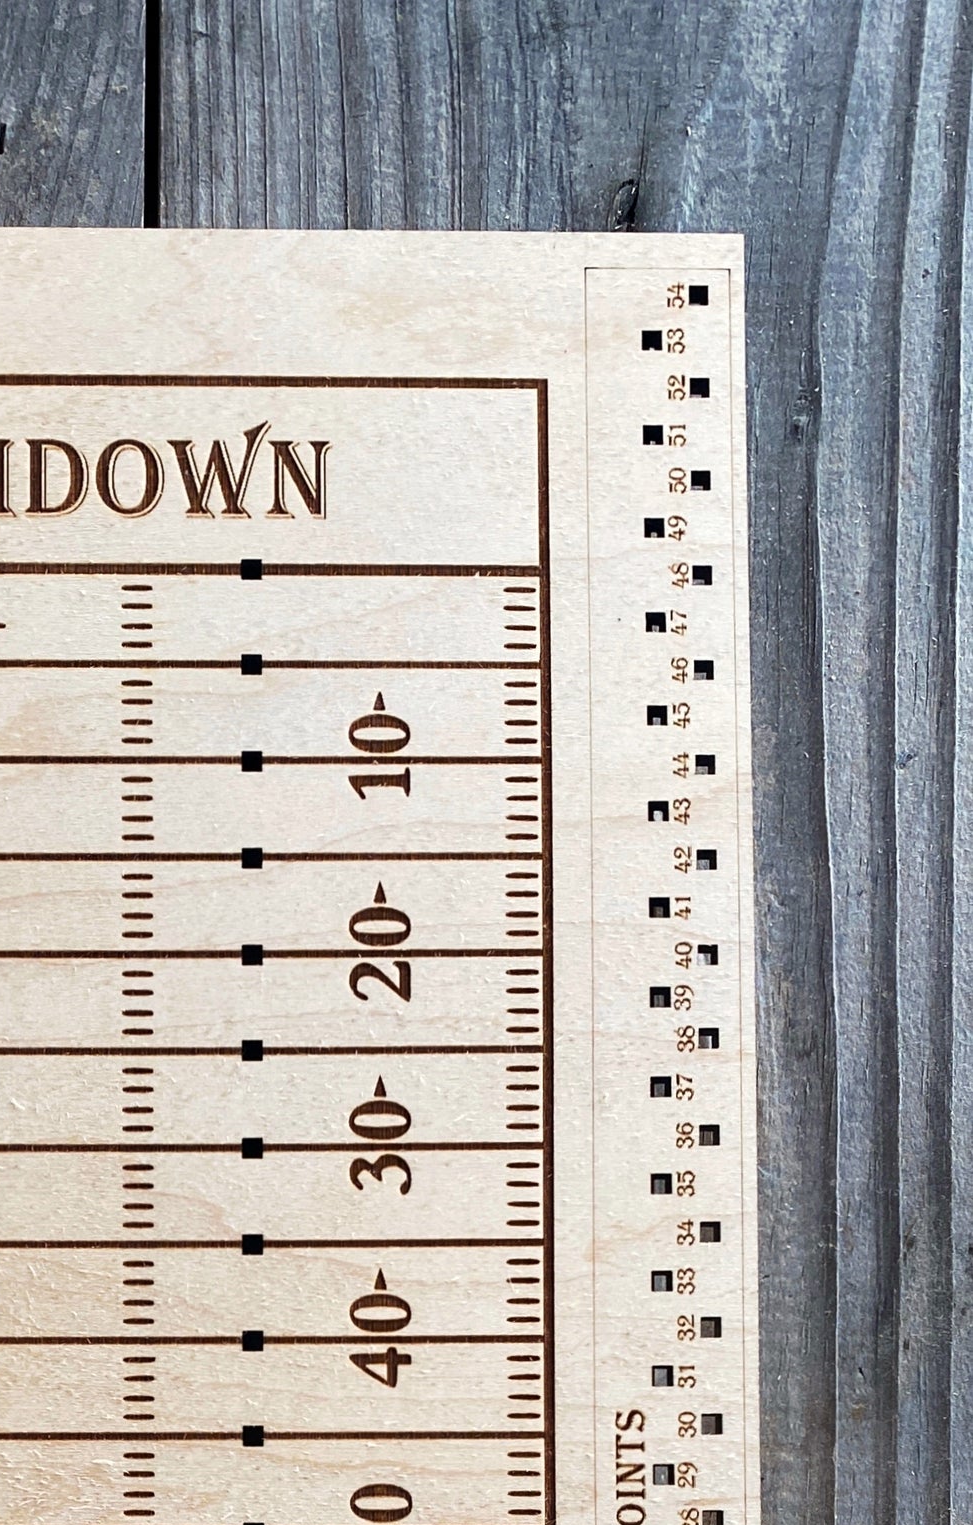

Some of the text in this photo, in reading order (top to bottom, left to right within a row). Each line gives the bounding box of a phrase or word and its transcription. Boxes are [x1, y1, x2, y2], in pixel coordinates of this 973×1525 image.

[666, 281, 686, 310] 54
[666, 327, 687, 355] 53
[666, 374, 687, 402] 52
[666, 423, 687, 448] 51
[667, 466, 688, 495] 50
[666, 514, 689, 542] 49
[667, 561, 690, 590] 48
[669, 609, 688, 637] 47
[670, 656, 689, 685] 46
[671, 701, 691, 730] 45
[347, 713, 412, 801] 10
[671, 751, 692, 780] 44
[672, 797, 692, 826] 43
[673, 845, 694, 875] 42
[673, 896, 692, 921] 41
[348, 905, 412, 1003] 20
[674, 940, 695, 970] 40
[673, 984, 695, 1012] 39
[673, 1024, 694, 1054] 38
[675, 1072, 695, 1102] 37
[348, 1099, 413, 1196] 30
[675, 1121, 696, 1150] 36
[675, 1169, 697, 1198] 35
[676, 1218, 696, 1247] 34
[676, 1266, 697, 1296] 33
[348, 1293, 413, 1389] 40
[676, 1313, 697, 1342] 32
[676, 1364, 698, 1389] 31
[677, 1410, 698, 1439] 30
[676, 1461, 699, 1489] 29
